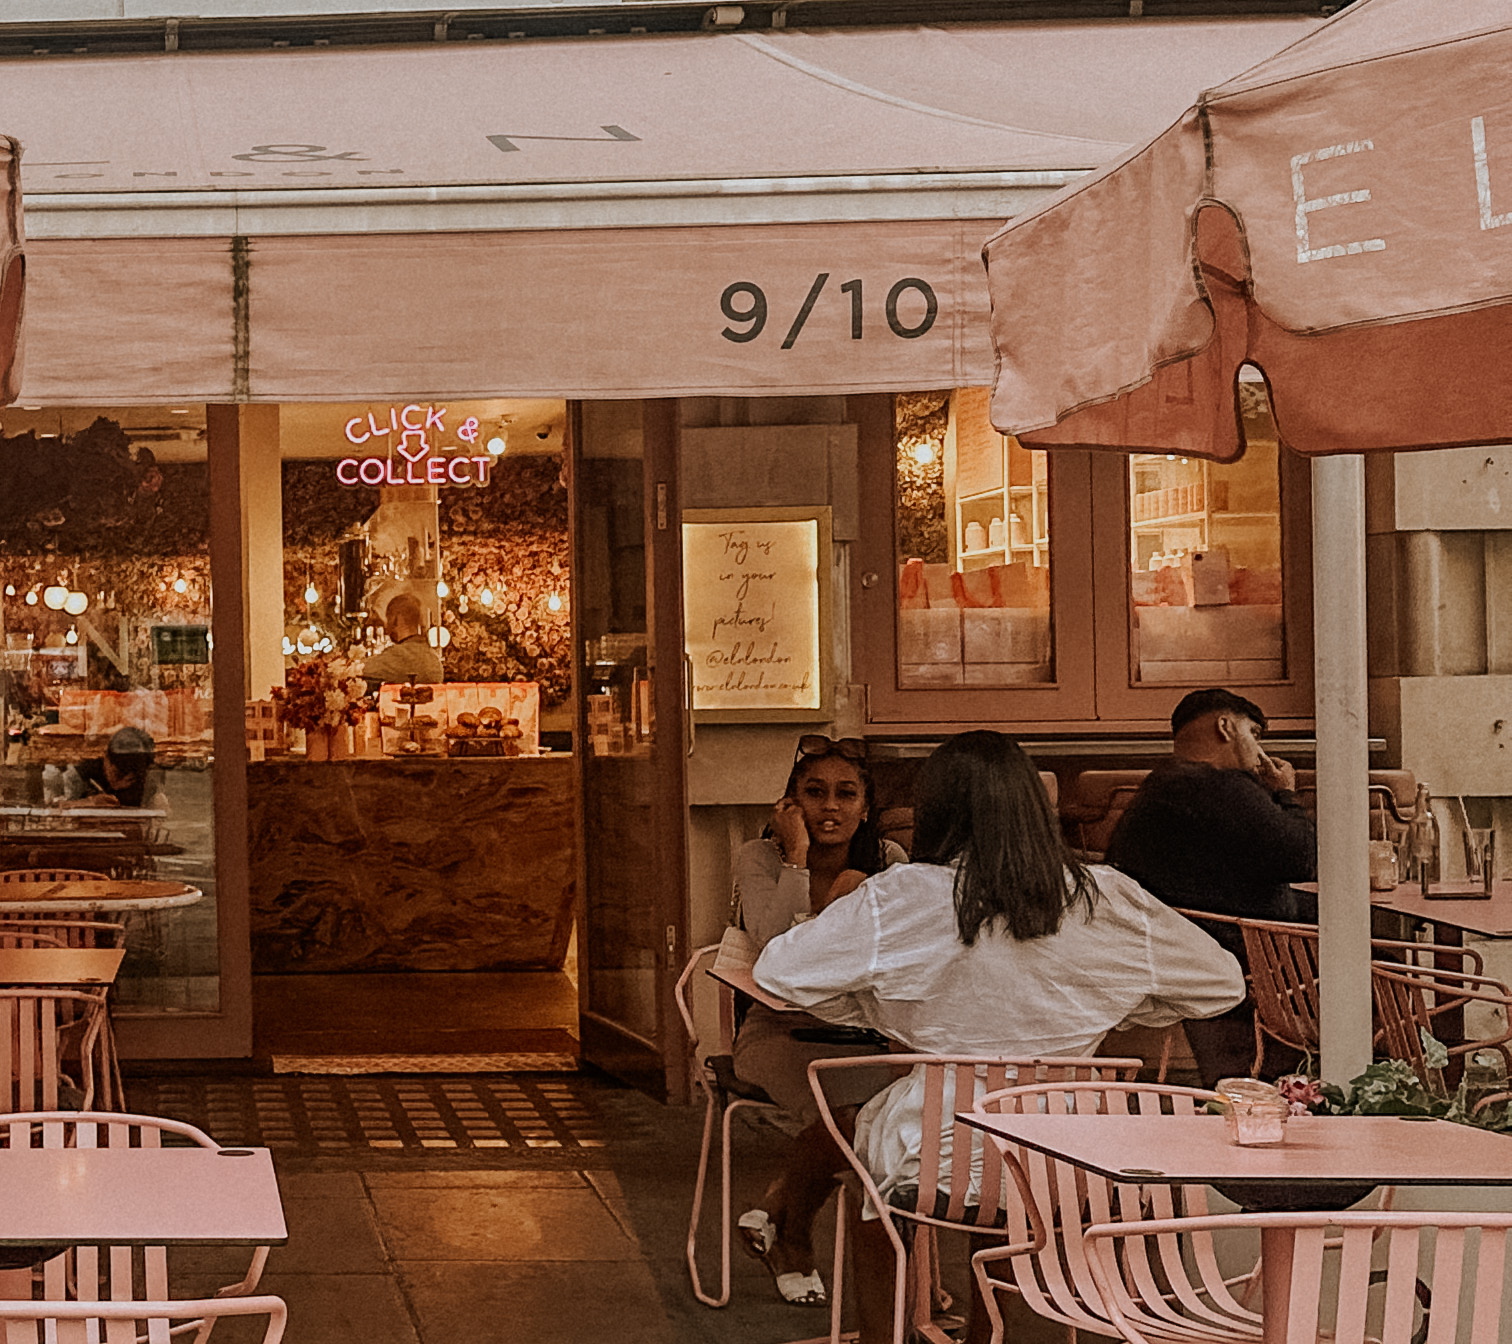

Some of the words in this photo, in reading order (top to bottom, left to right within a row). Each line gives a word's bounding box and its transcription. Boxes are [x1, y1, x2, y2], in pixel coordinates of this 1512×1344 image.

[23, 168, 404, 180] ONDON
[719, 271, 938, 350] 9/10
[345, 404, 447, 444] CLICK
[456, 416, 479, 444] &
[336, 455, 491, 486] COLLECT
[718, 530, 749, 566] Tag
[756, 539, 776, 556] us
[719, 570, 734, 581] in
[735, 570, 778, 602] your
[711, 601, 777, 641] pictures!
